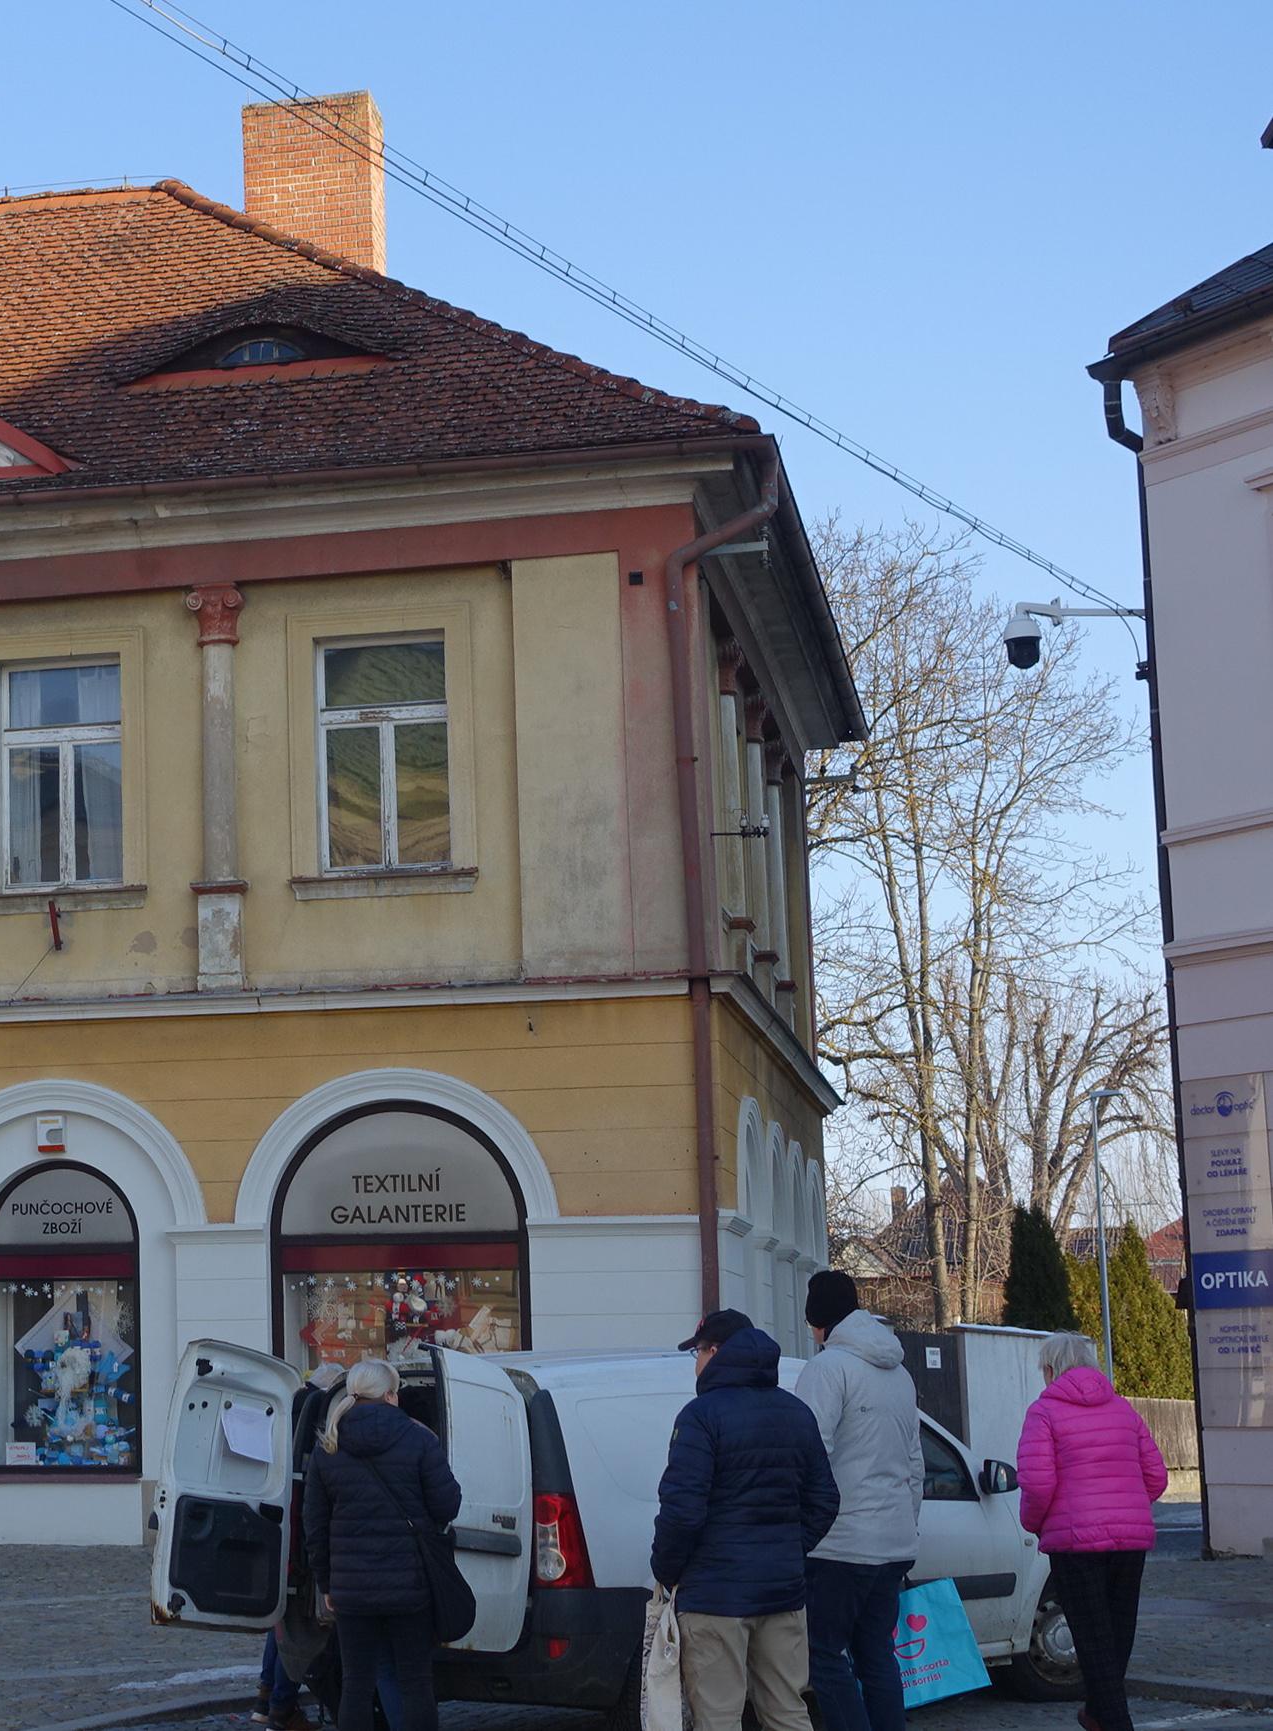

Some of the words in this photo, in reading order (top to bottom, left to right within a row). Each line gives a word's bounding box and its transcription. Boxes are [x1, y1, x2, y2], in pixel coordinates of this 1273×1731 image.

[352, 1167, 442, 1194] TEXTILNÍ
[11, 1198, 114, 1216] PUNČOCHOVÉ
[330, 1203, 467, 1225] GALANTERIE
[42, 1218, 83, 1235] ZBOŽÍ
[1200, 1270, 1269, 1290] OPTIKA
